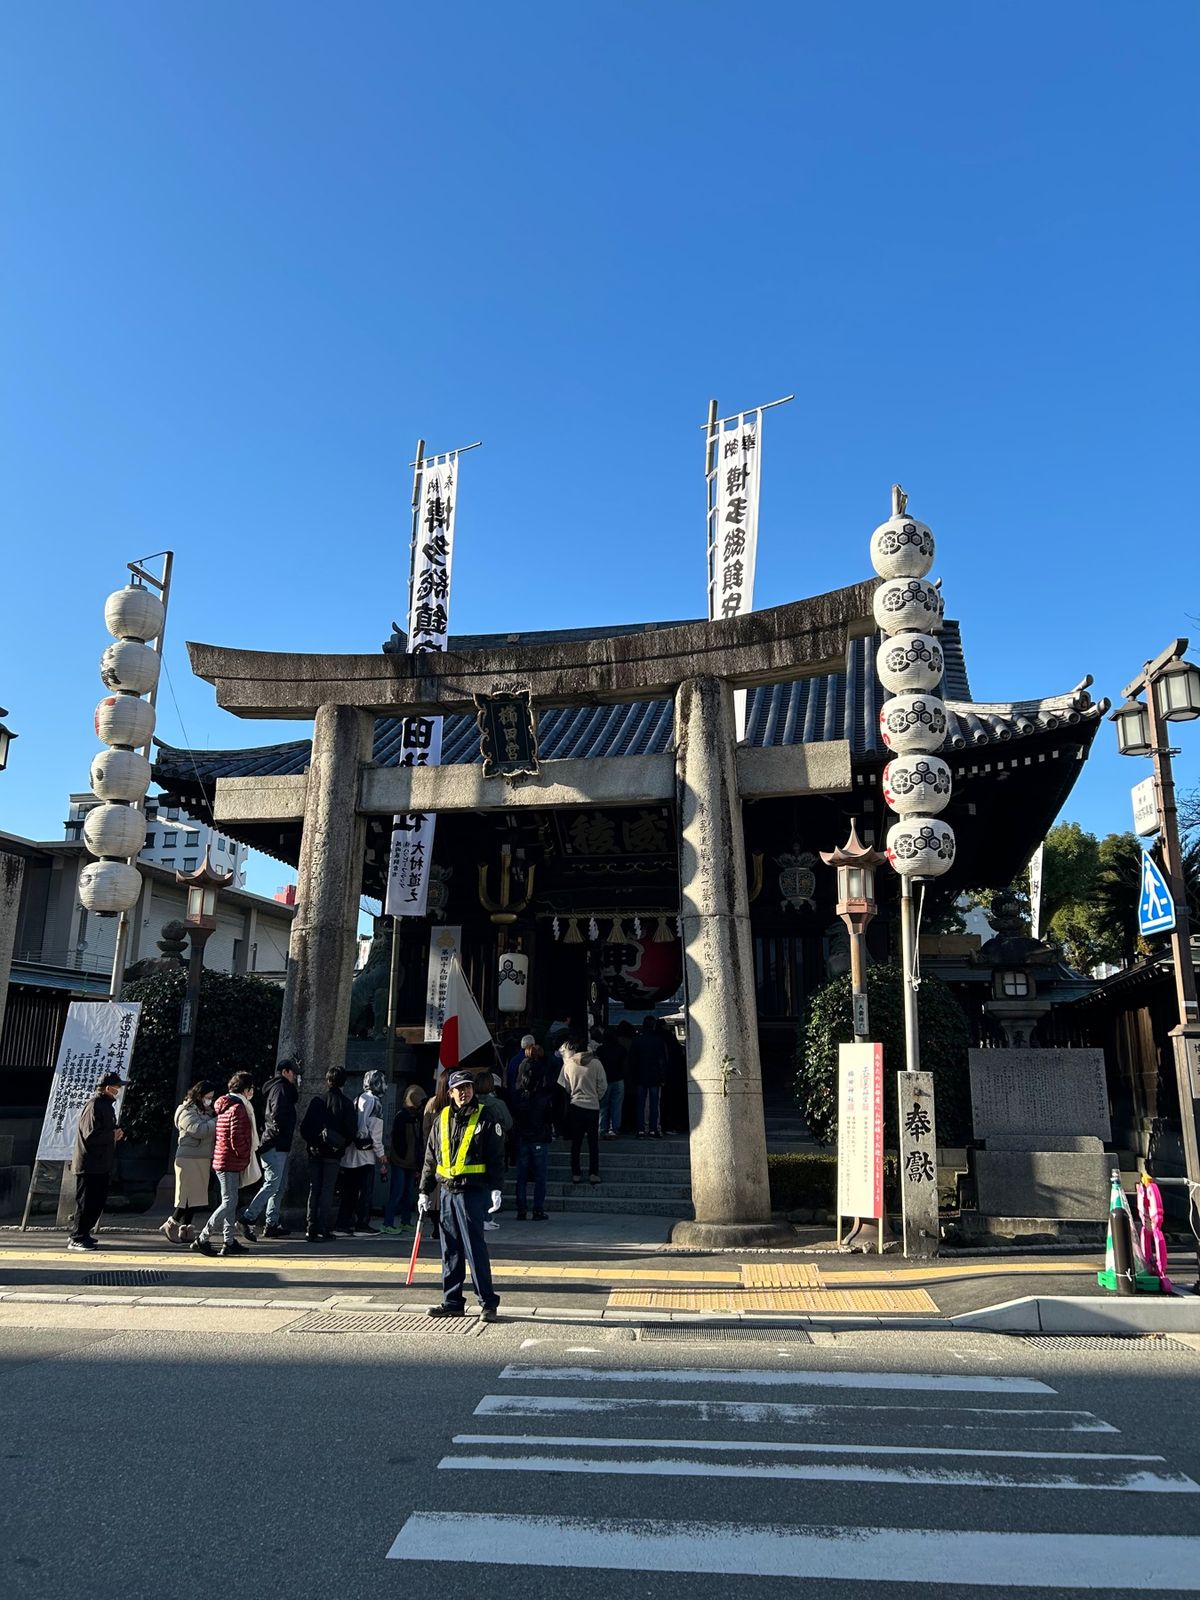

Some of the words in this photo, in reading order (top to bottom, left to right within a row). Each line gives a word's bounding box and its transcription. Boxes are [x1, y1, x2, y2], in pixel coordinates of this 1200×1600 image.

[114, 1013, 134, 1075] 櫛田神社年末
